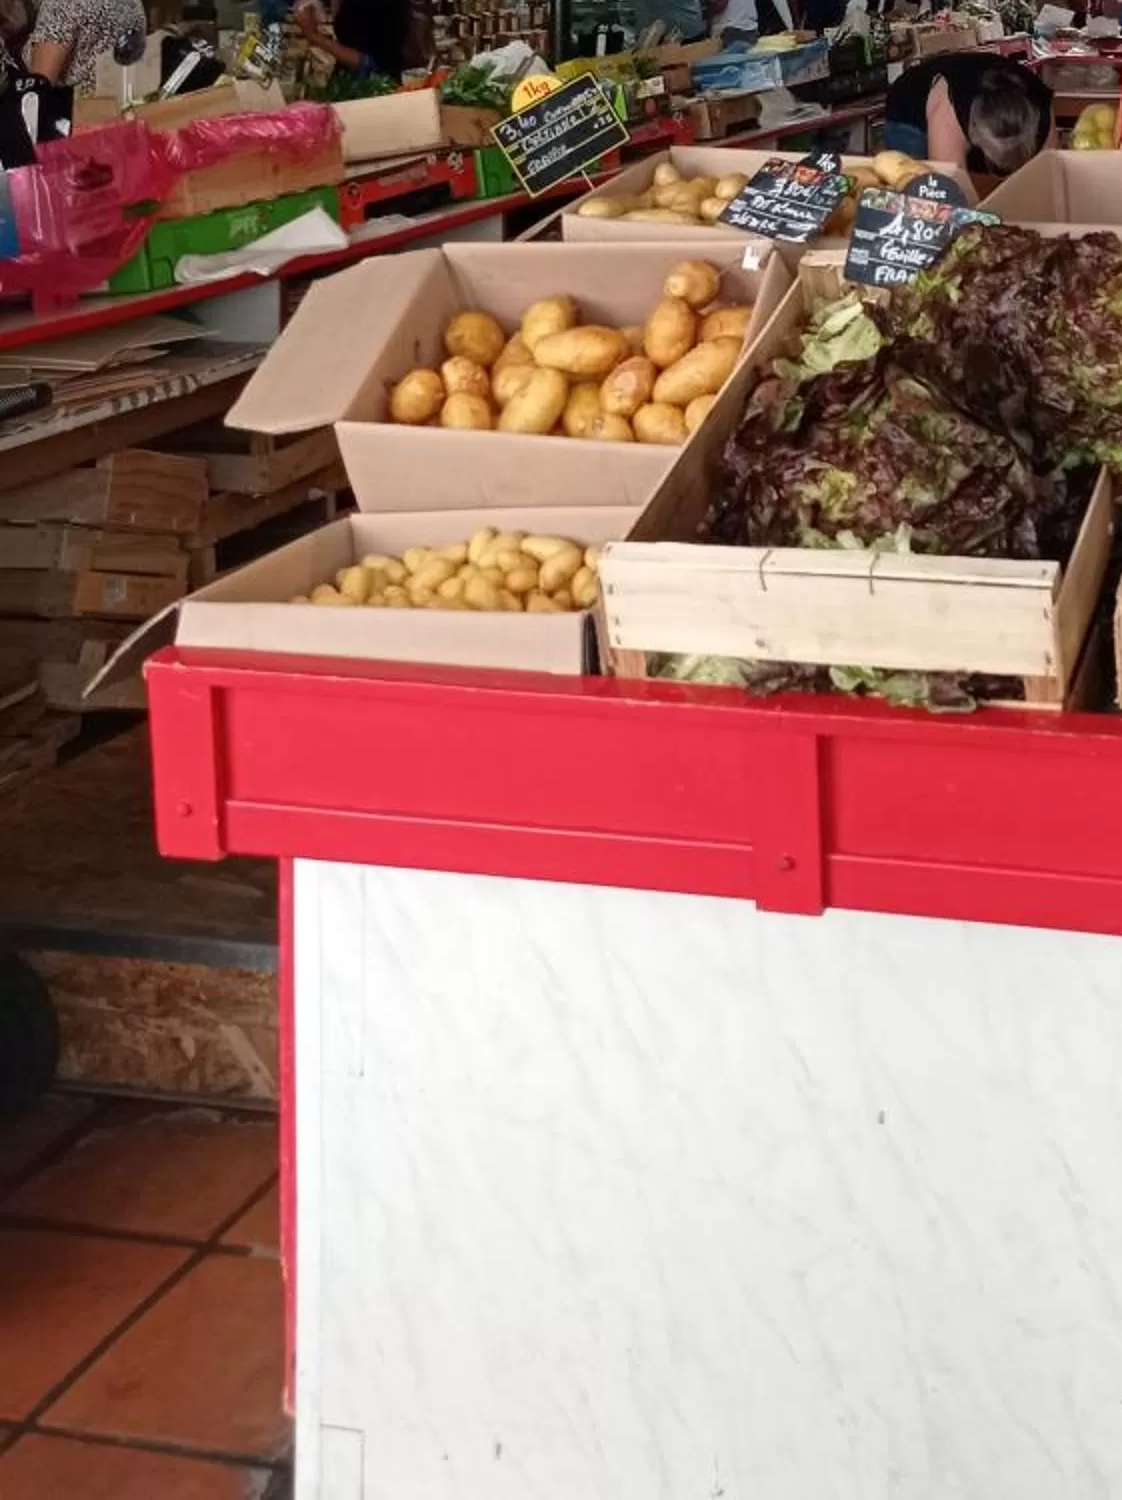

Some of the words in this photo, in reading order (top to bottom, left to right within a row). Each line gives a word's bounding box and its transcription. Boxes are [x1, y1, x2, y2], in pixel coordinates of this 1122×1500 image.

[523, 81, 552, 100] 1kg
[928, 175, 938, 187] la
[919, 185, 947, 199] Pièce
